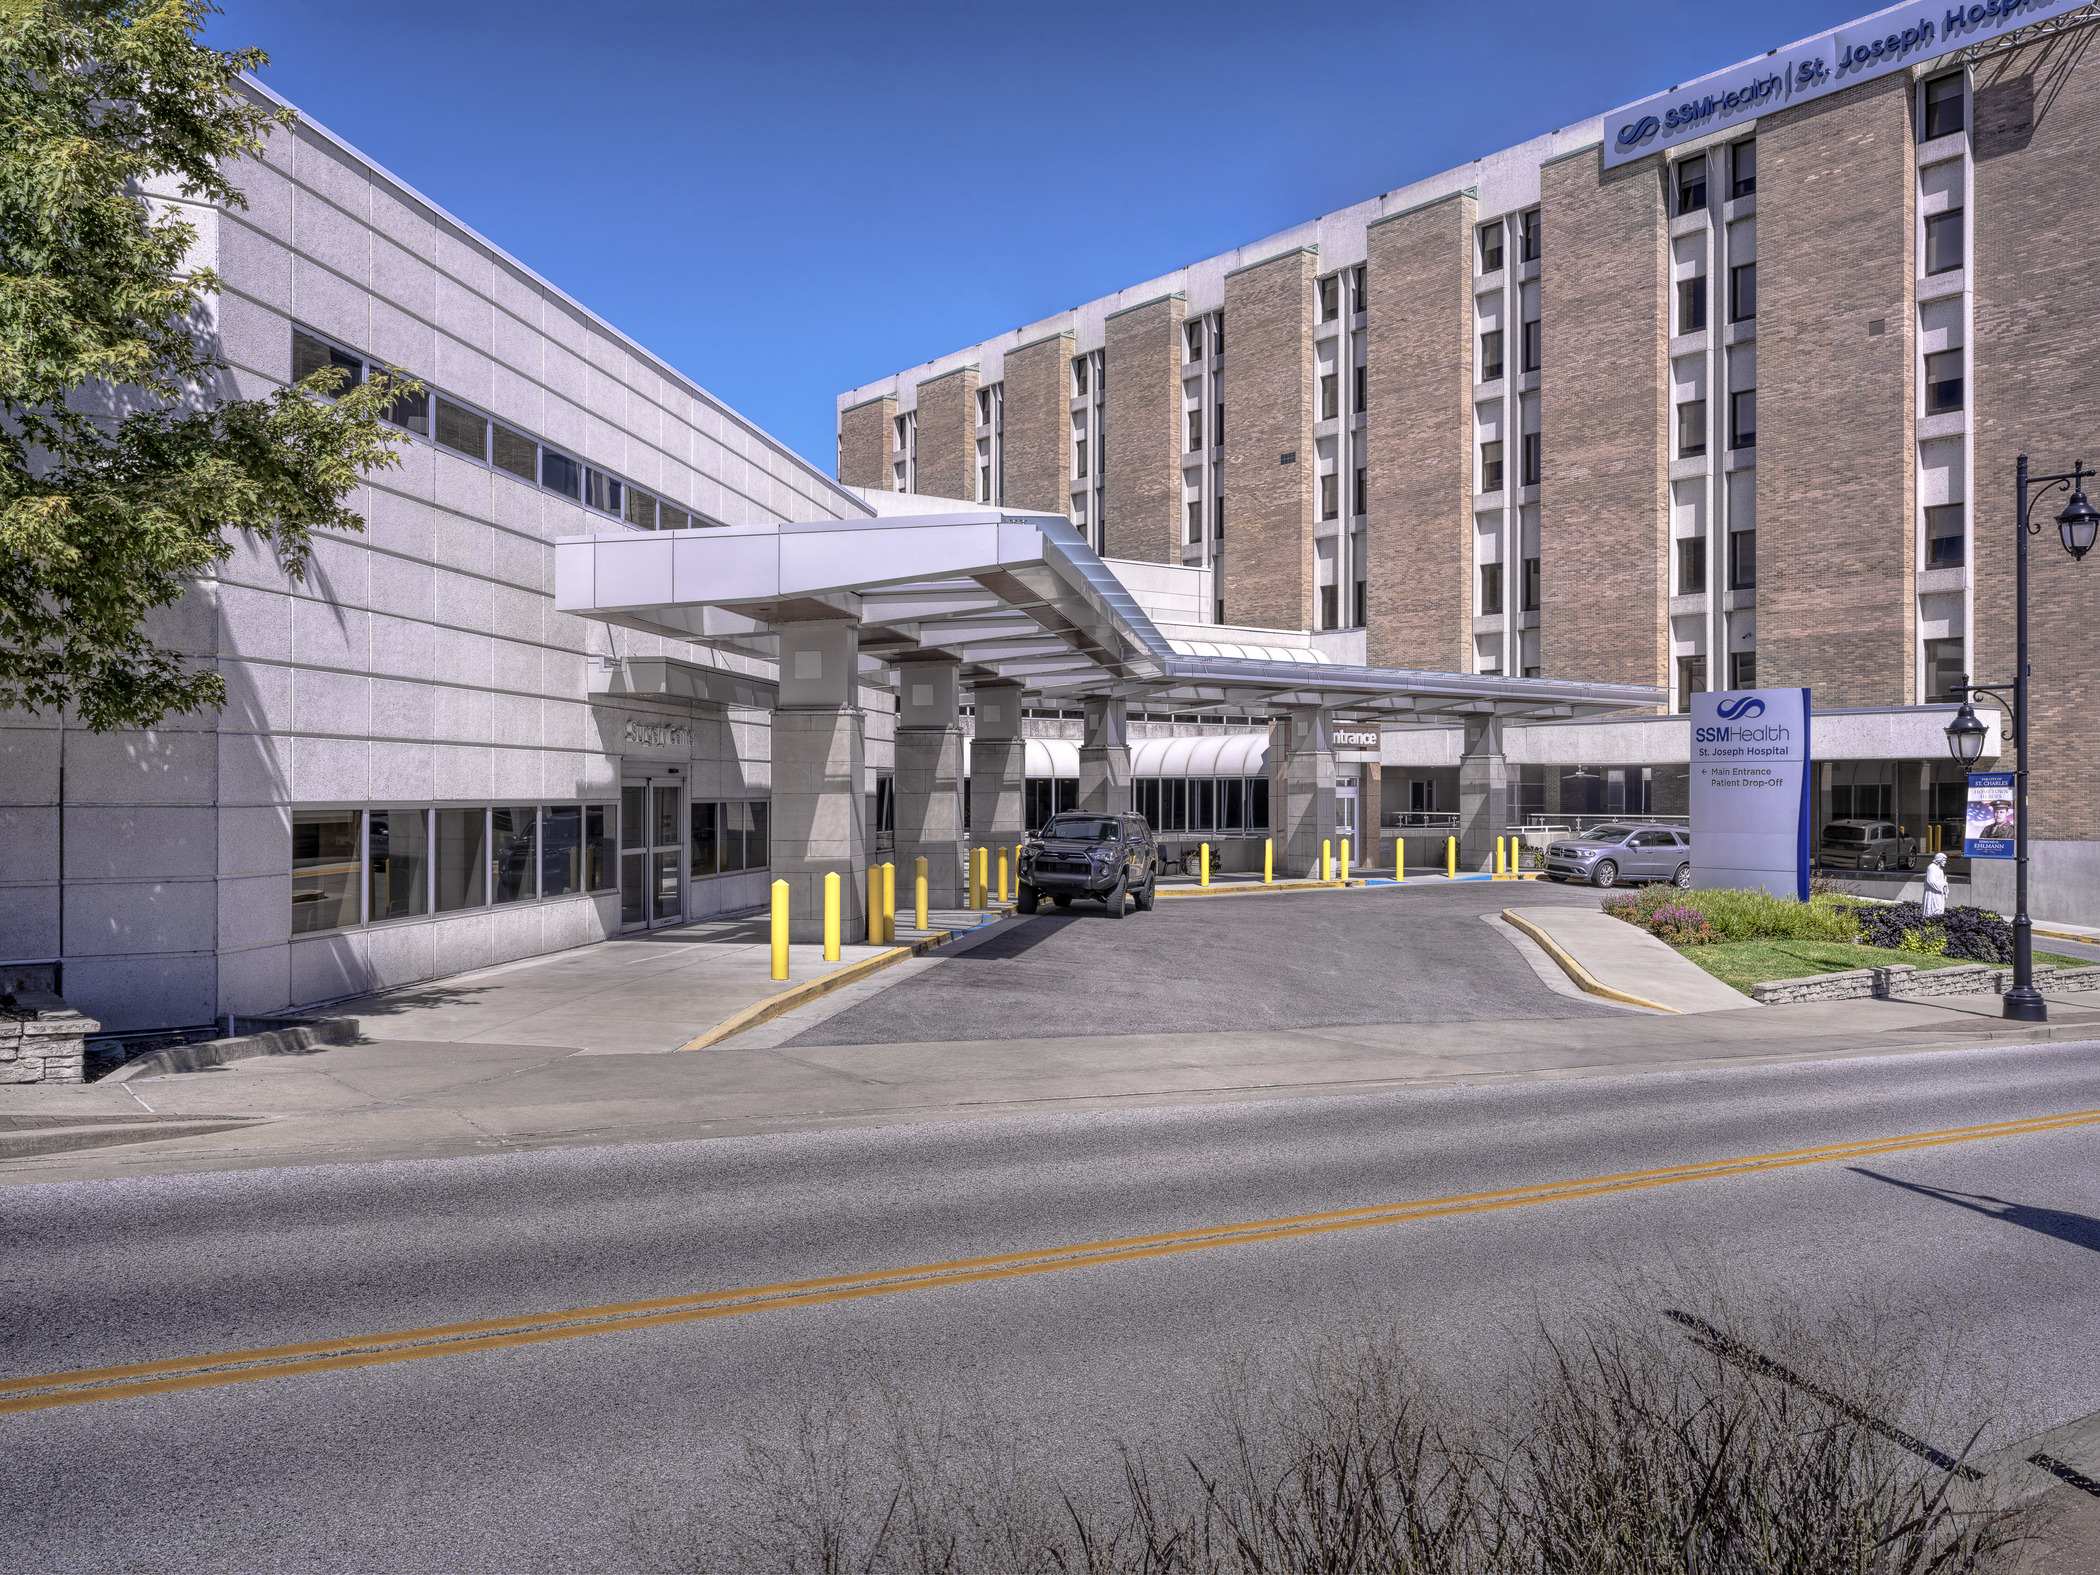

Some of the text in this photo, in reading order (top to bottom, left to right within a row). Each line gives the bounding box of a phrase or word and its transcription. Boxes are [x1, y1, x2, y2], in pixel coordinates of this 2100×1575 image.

[1665, 0, 2030, 128] SSMHealth St. Joseph Hosp
[626, 720, 697, 748] Surgery Center
[1333, 729, 1378, 745] ntrance
[1695, 724, 1790, 742] SSMHealth
[1699, 746, 1789, 757] St. Joseph Hospital
[1711, 767, 1772, 776] Main Entrance
[1711, 778, 1784, 788] Patient Drop-Off
